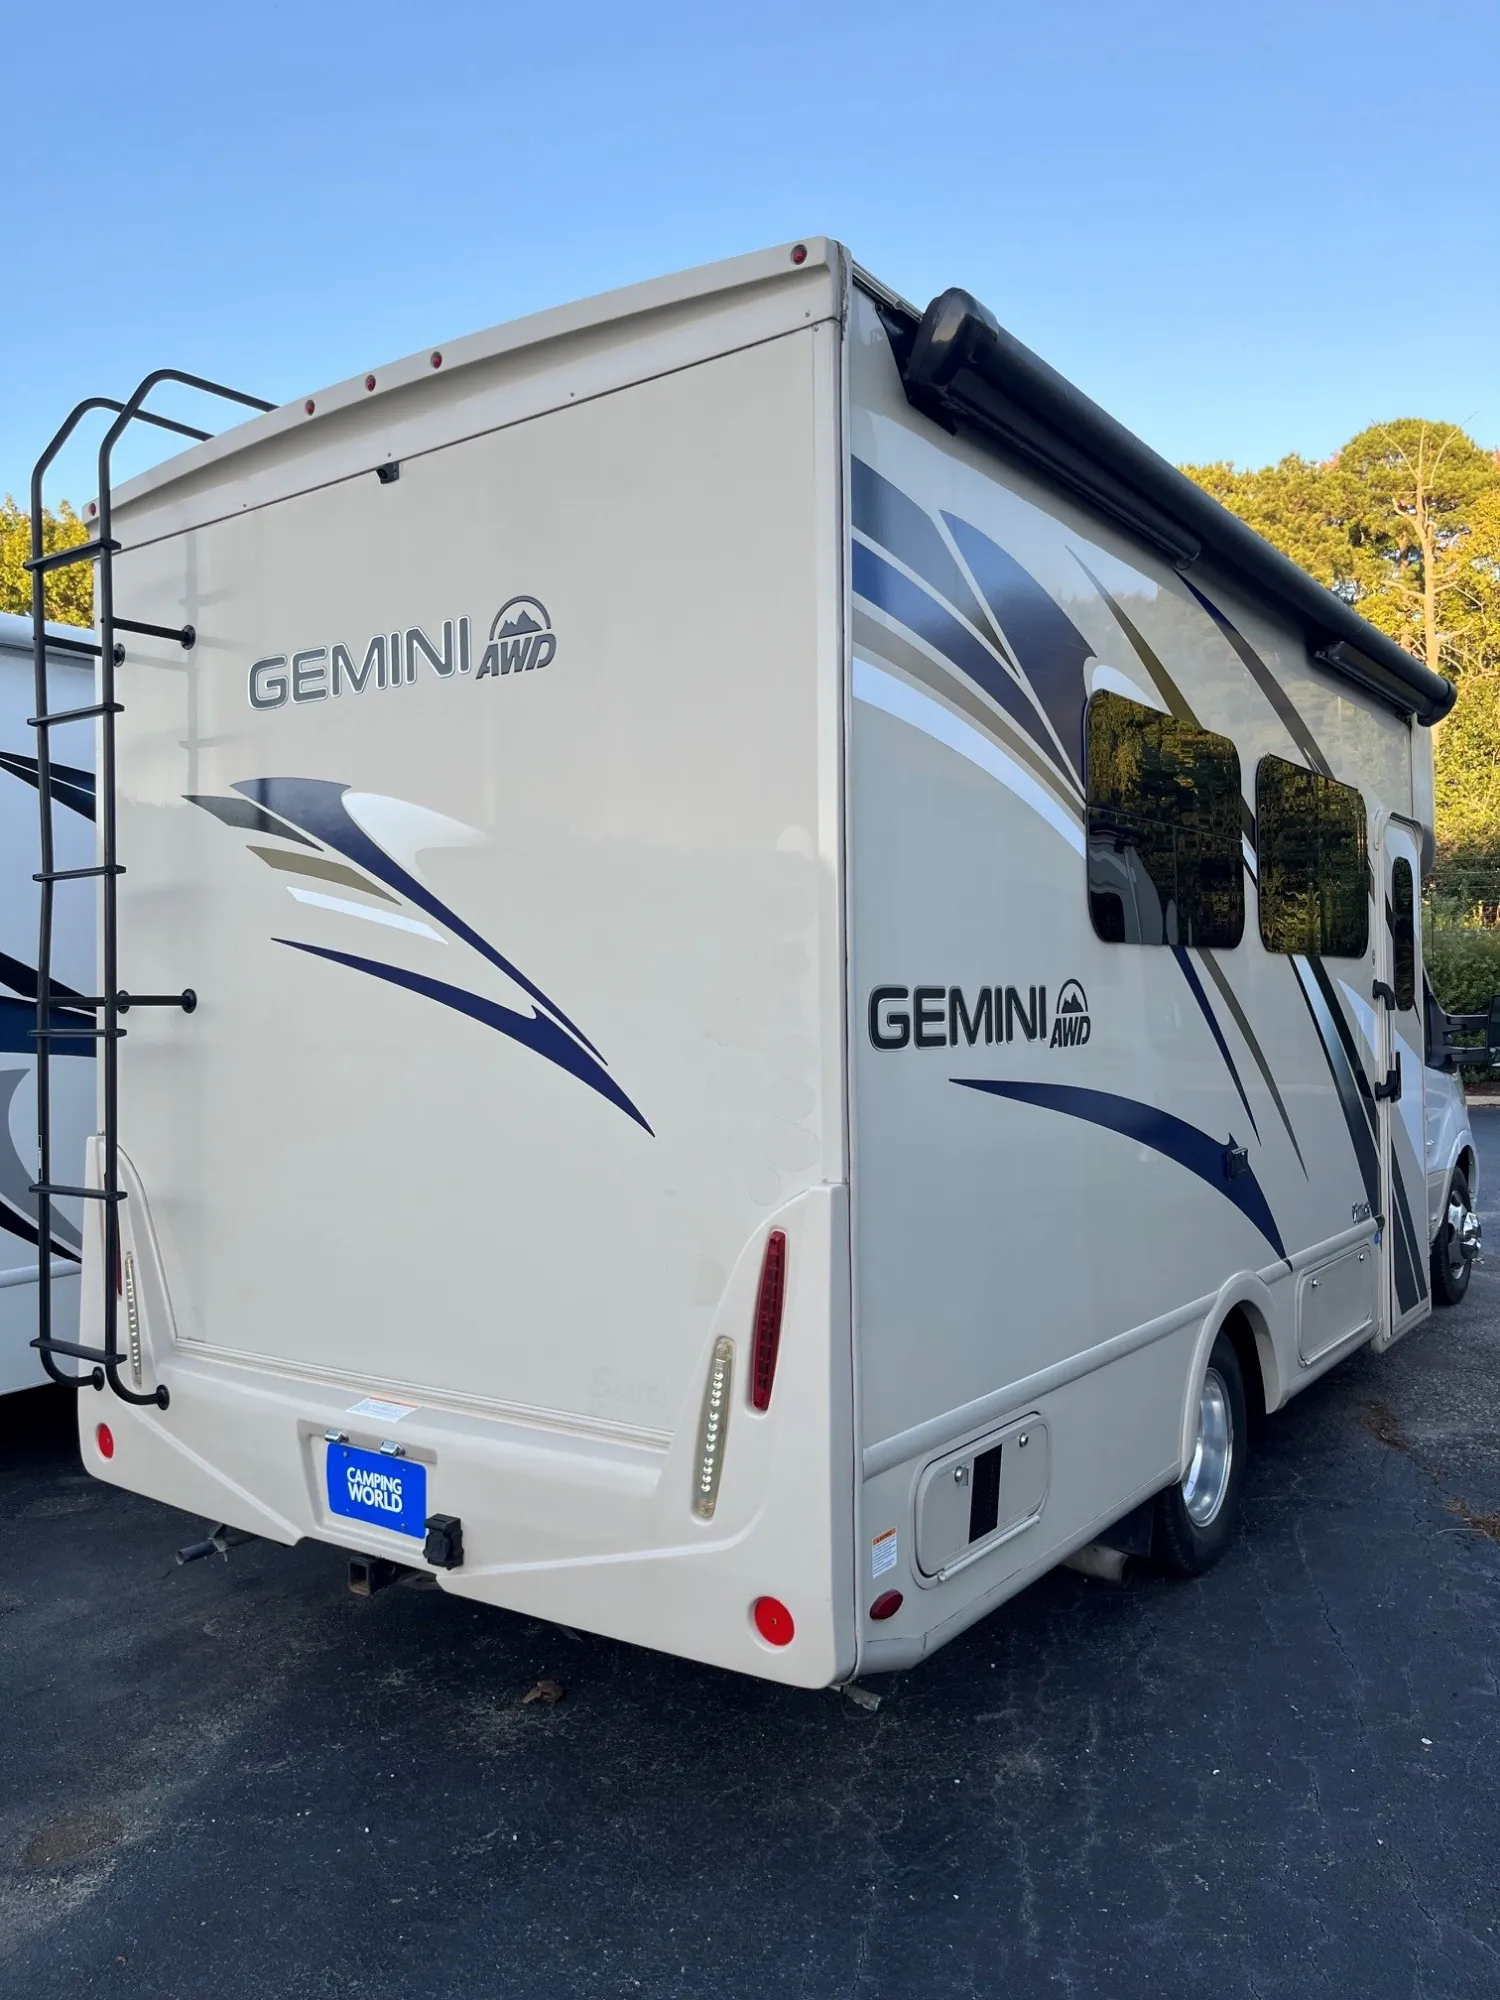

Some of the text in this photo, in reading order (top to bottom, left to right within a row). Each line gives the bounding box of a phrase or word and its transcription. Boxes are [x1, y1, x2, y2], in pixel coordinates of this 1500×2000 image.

[247, 614, 558, 711] GEMINI AWD
[868, 984, 1091, 1052] GEMINI AWD
[346, 1466, 403, 1495] CAMPING
[347, 1481, 404, 1513] WORLD
